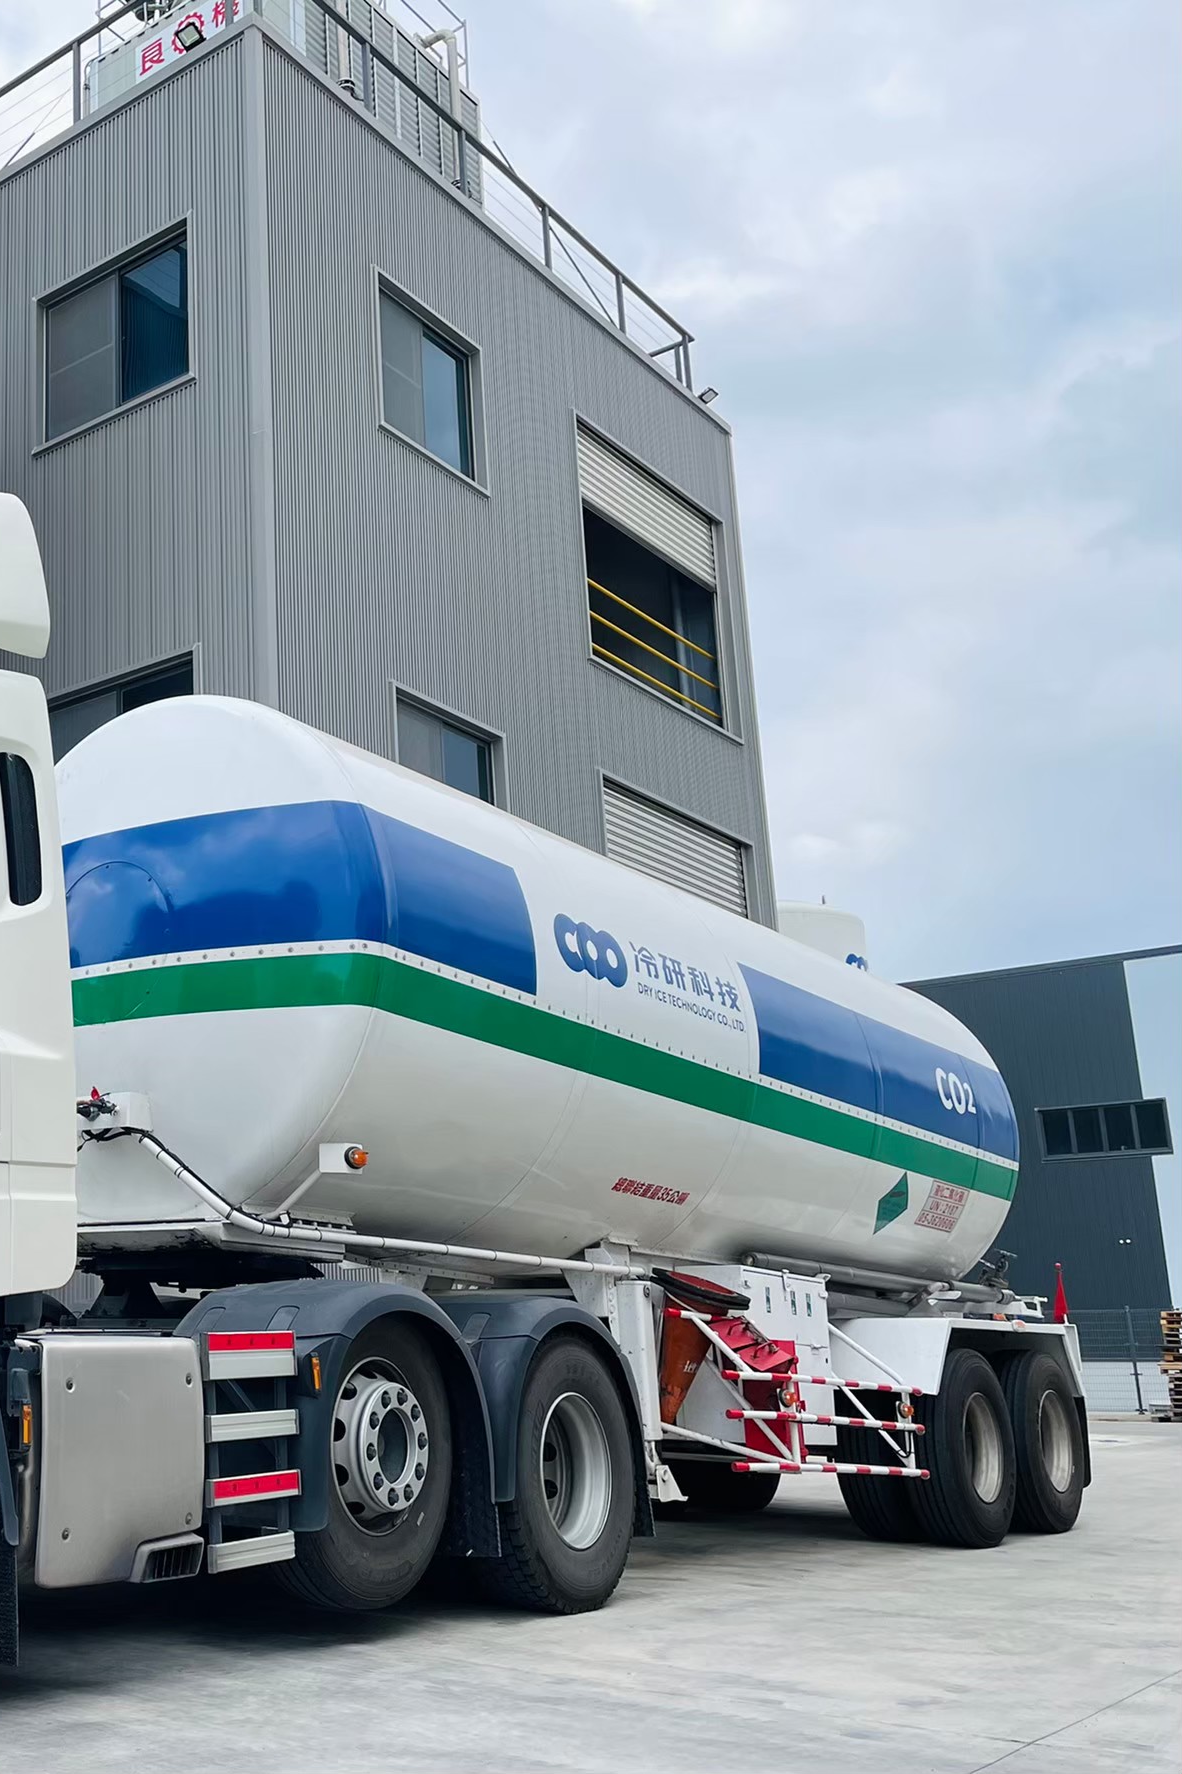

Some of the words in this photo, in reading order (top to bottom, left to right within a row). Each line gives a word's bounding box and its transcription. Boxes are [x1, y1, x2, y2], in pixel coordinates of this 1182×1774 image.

[629, 941, 741, 1012] 冷研科技
[638, 982, 653, 997] DRY
[654, 990, 667, 1004] ICE
[668, 994, 716, 1021] TECHNOLOGY
[935, 1067, 977, 1115] CO2
